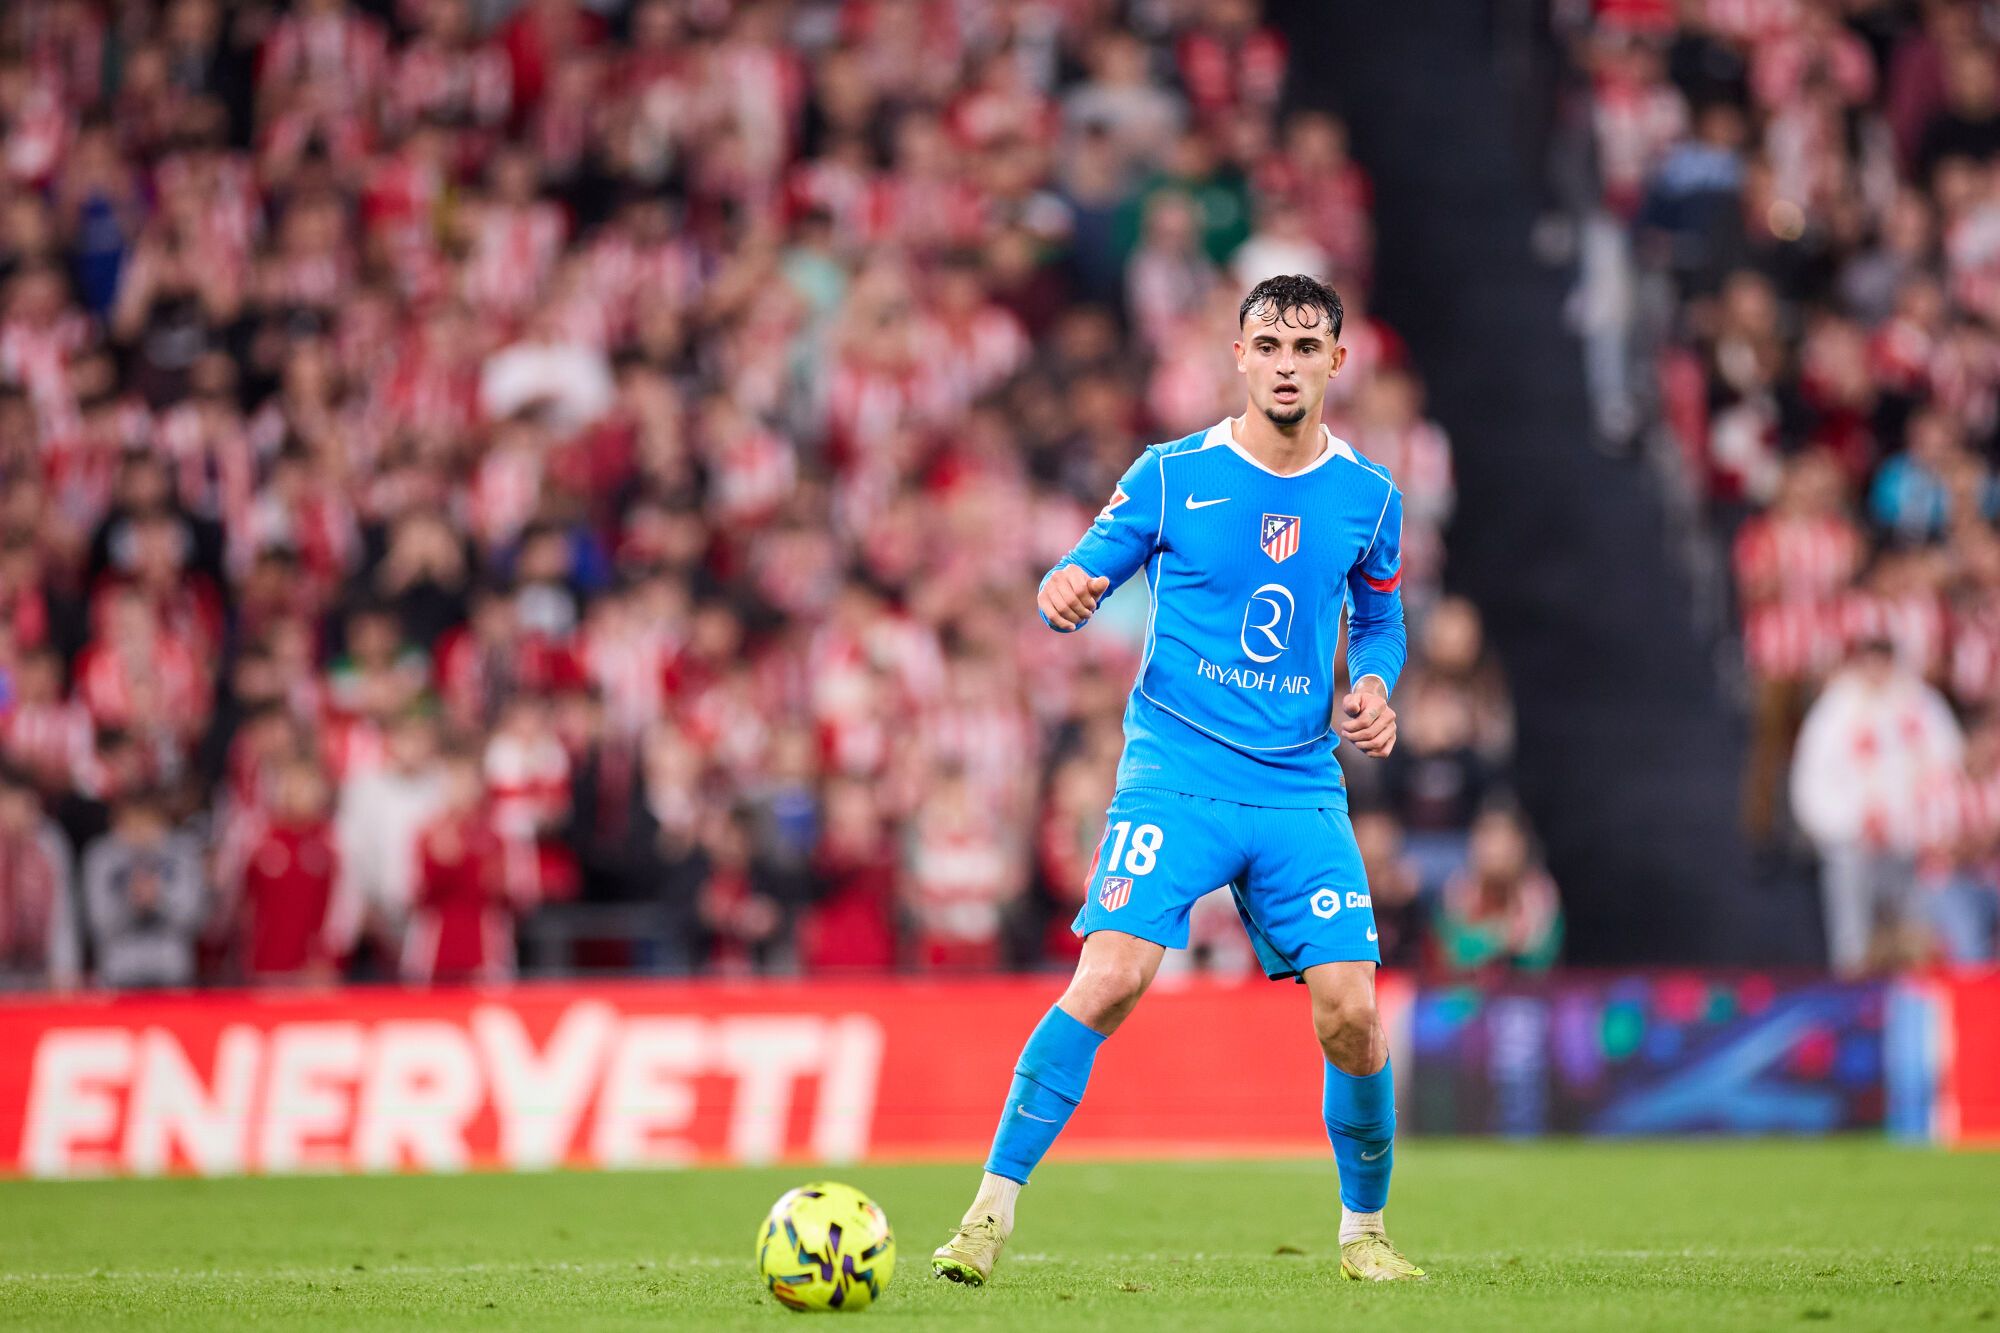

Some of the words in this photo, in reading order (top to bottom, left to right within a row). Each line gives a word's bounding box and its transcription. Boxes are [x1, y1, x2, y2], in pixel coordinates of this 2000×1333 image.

[1197, 658, 1276, 692] RIYADH
[1279, 676, 1311, 695] AIR
[1107, 821, 1164, 876] 18
[22, 1002, 884, 1177] ENERYETI
